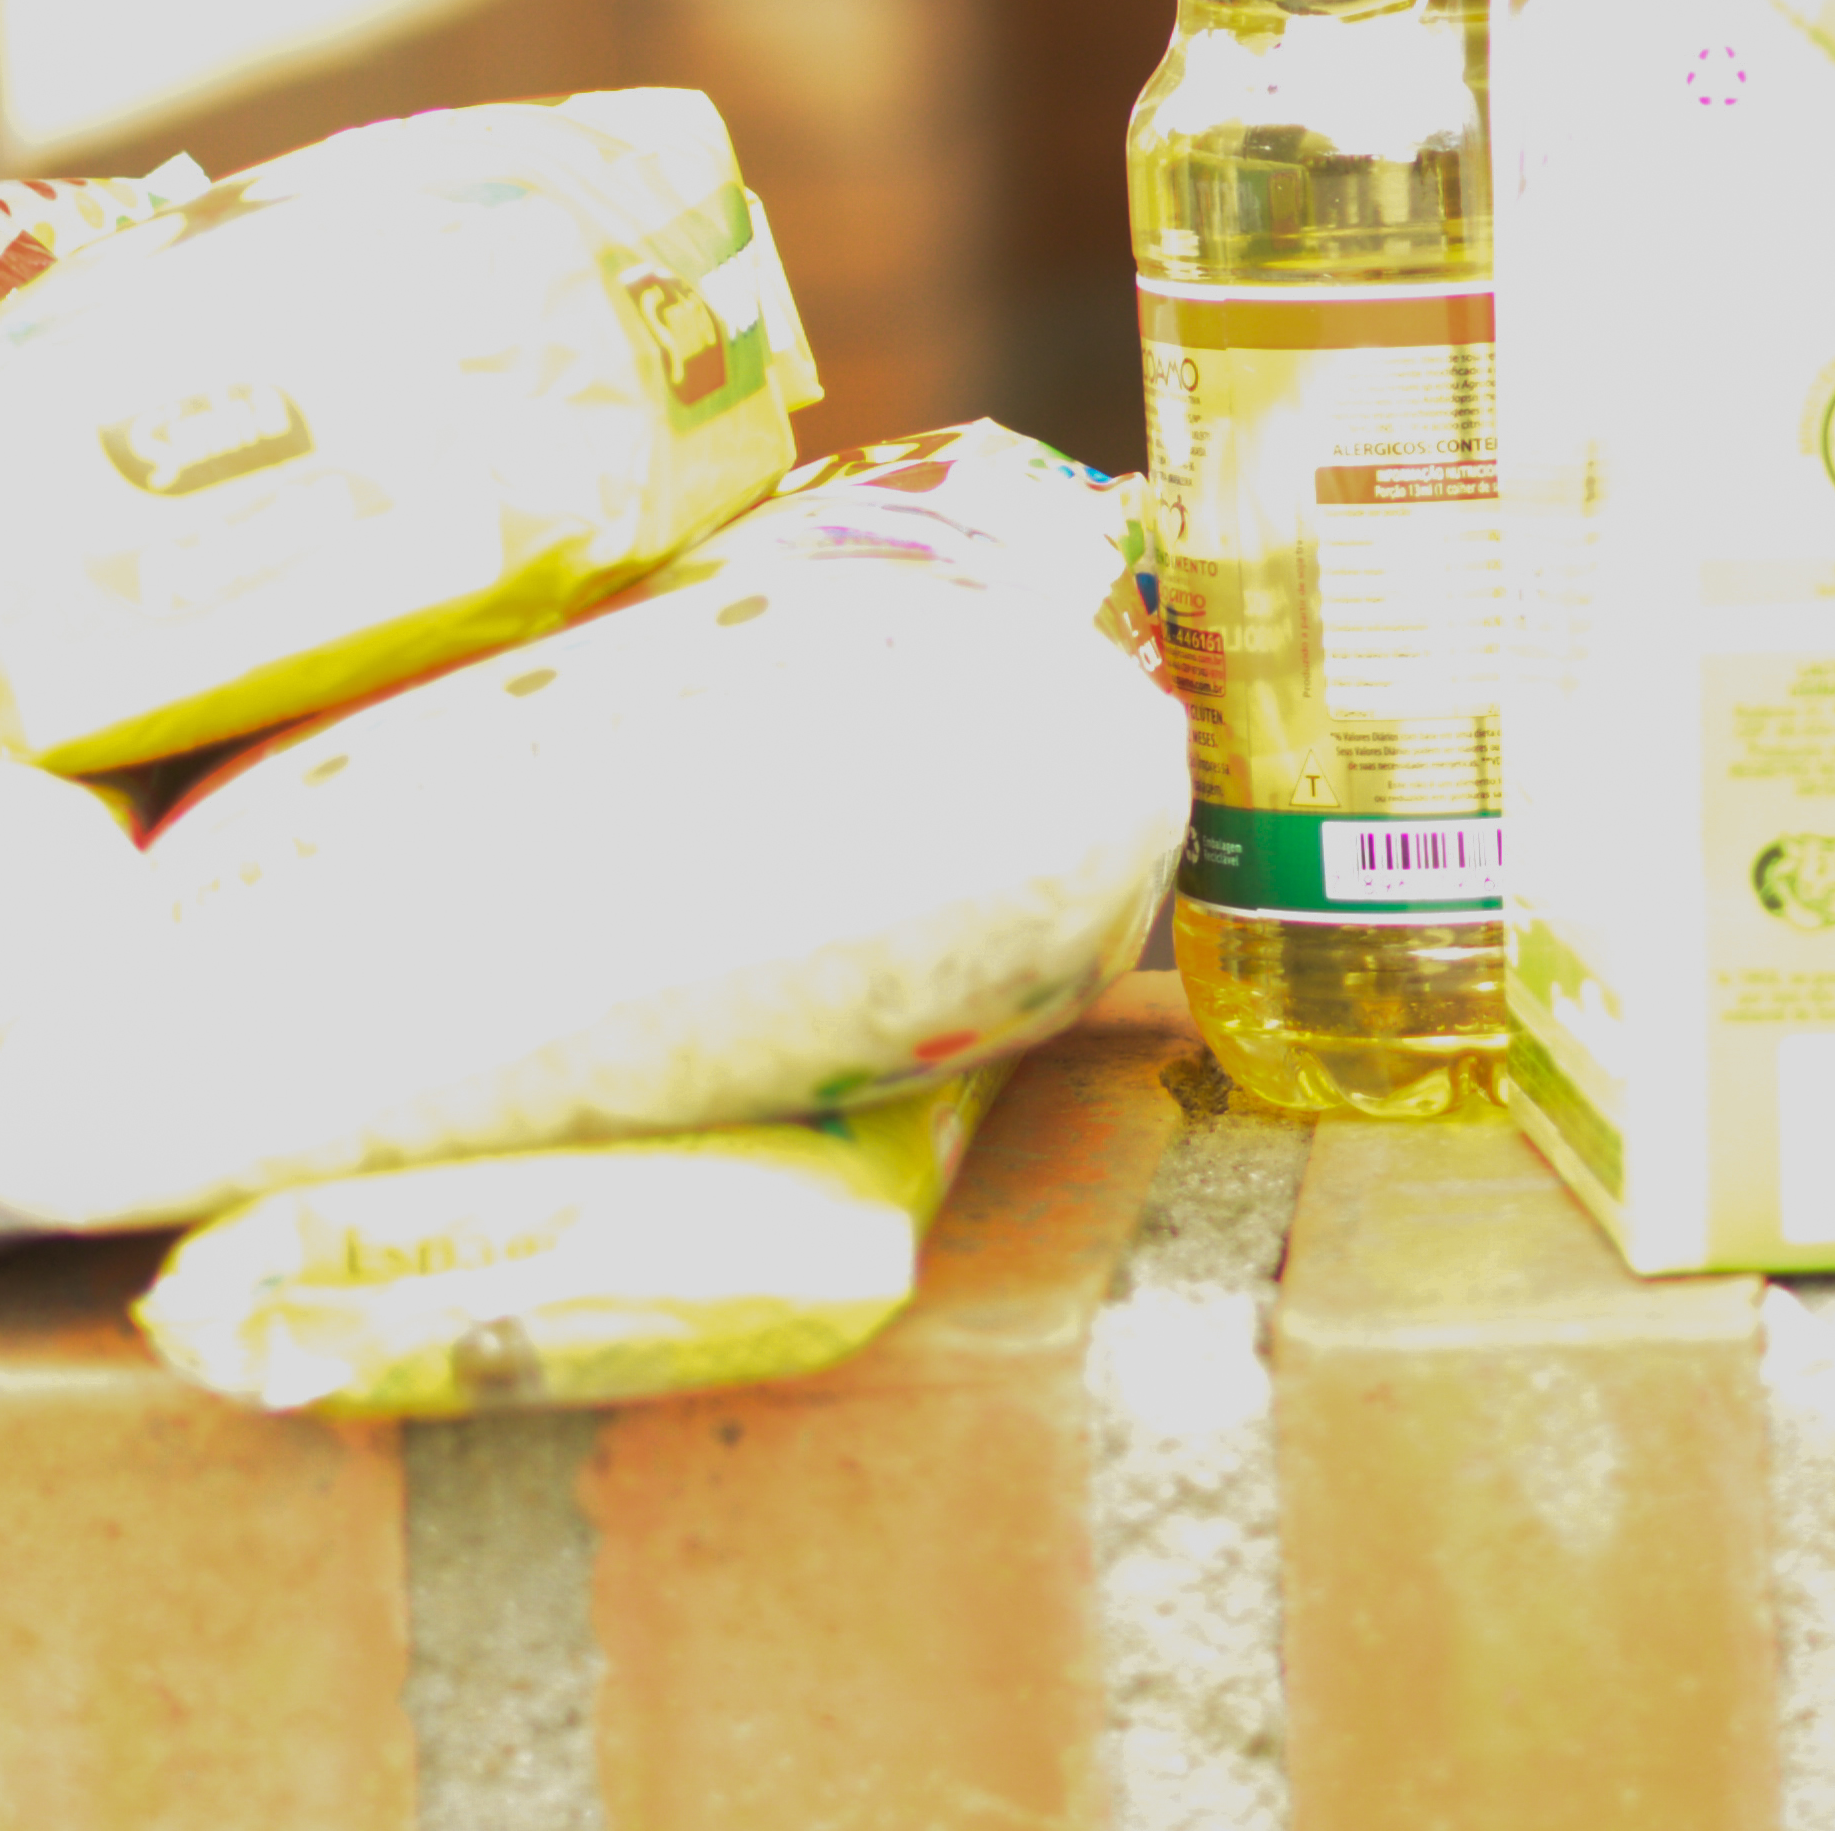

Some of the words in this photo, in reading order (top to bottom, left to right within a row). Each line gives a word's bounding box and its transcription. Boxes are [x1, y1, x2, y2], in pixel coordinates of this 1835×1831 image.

[1436, 437, 1498, 454] CONTE
[1446, 463, 1498, 480] NUTRICIO
[1155, 548, 1219, 577] ENDIMENTO
[1160, 586, 1207, 610] oamo
[1165, 626, 1223, 653] -446161
